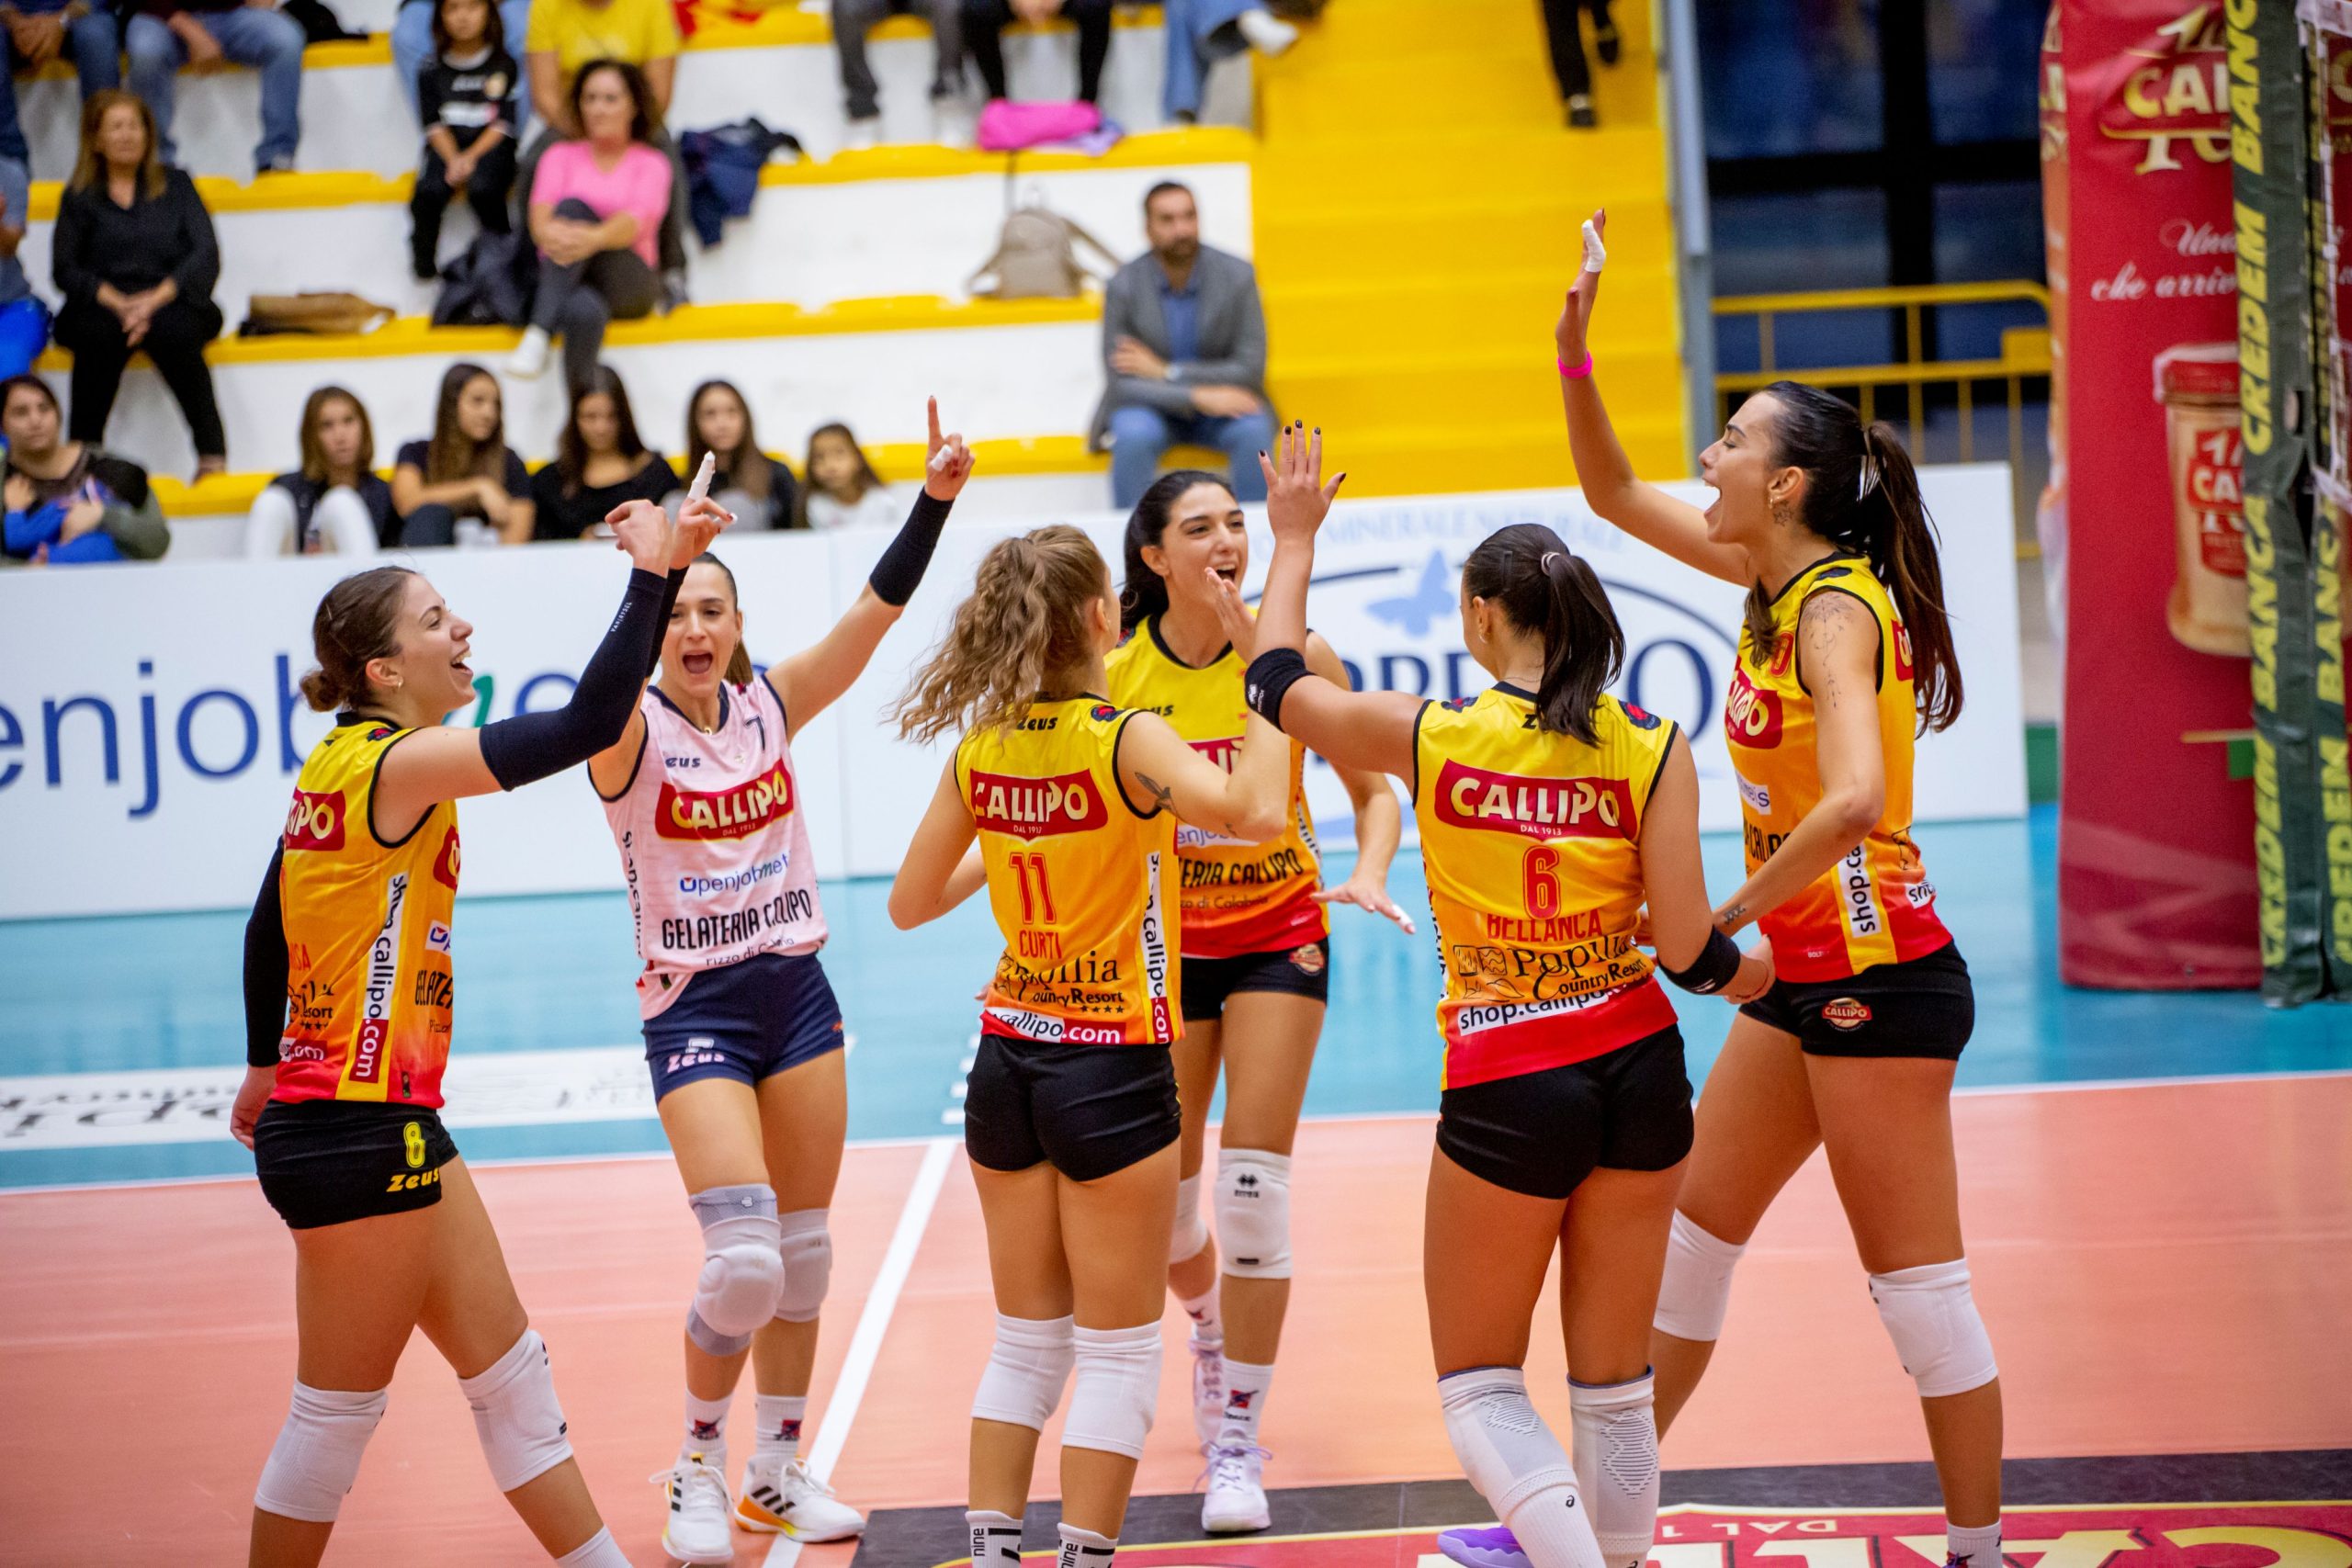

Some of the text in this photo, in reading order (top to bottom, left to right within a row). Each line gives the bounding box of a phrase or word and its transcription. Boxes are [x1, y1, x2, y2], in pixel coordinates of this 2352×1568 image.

[2223, 0, 2272, 456] CREDEM BANC
[2244, 495, 2278, 712] BANCA
[745, 716, 766, 751] 7
[665, 758, 701, 768] eus
[671, 771, 787, 830] CALLIPO
[975, 781, 1089, 821] CALLIPO
[1450, 777, 1620, 828] CALLIPO
[1013, 825, 1026, 834] DAL
[1520, 824, 1562, 836] DAL 1913
[1228, 848, 1304, 885] CALLIPO
[1522, 844, 1562, 920] 6
[1009, 852, 1057, 925] 11
[662, 908, 761, 950] GELATERIA
[1487, 908, 1603, 943] BELLANCA
[1019, 930, 1062, 960] CURTI
[1070, 987, 1125, 1003] Resort
[1825, 1006, 1868, 1018] CALLIPO
[667, 1052, 725, 1073] Zeus
[403, 1122, 425, 1168] 8
[386, 1168, 439, 1192] Zeus
[971, 1528, 986, 1557] nine
